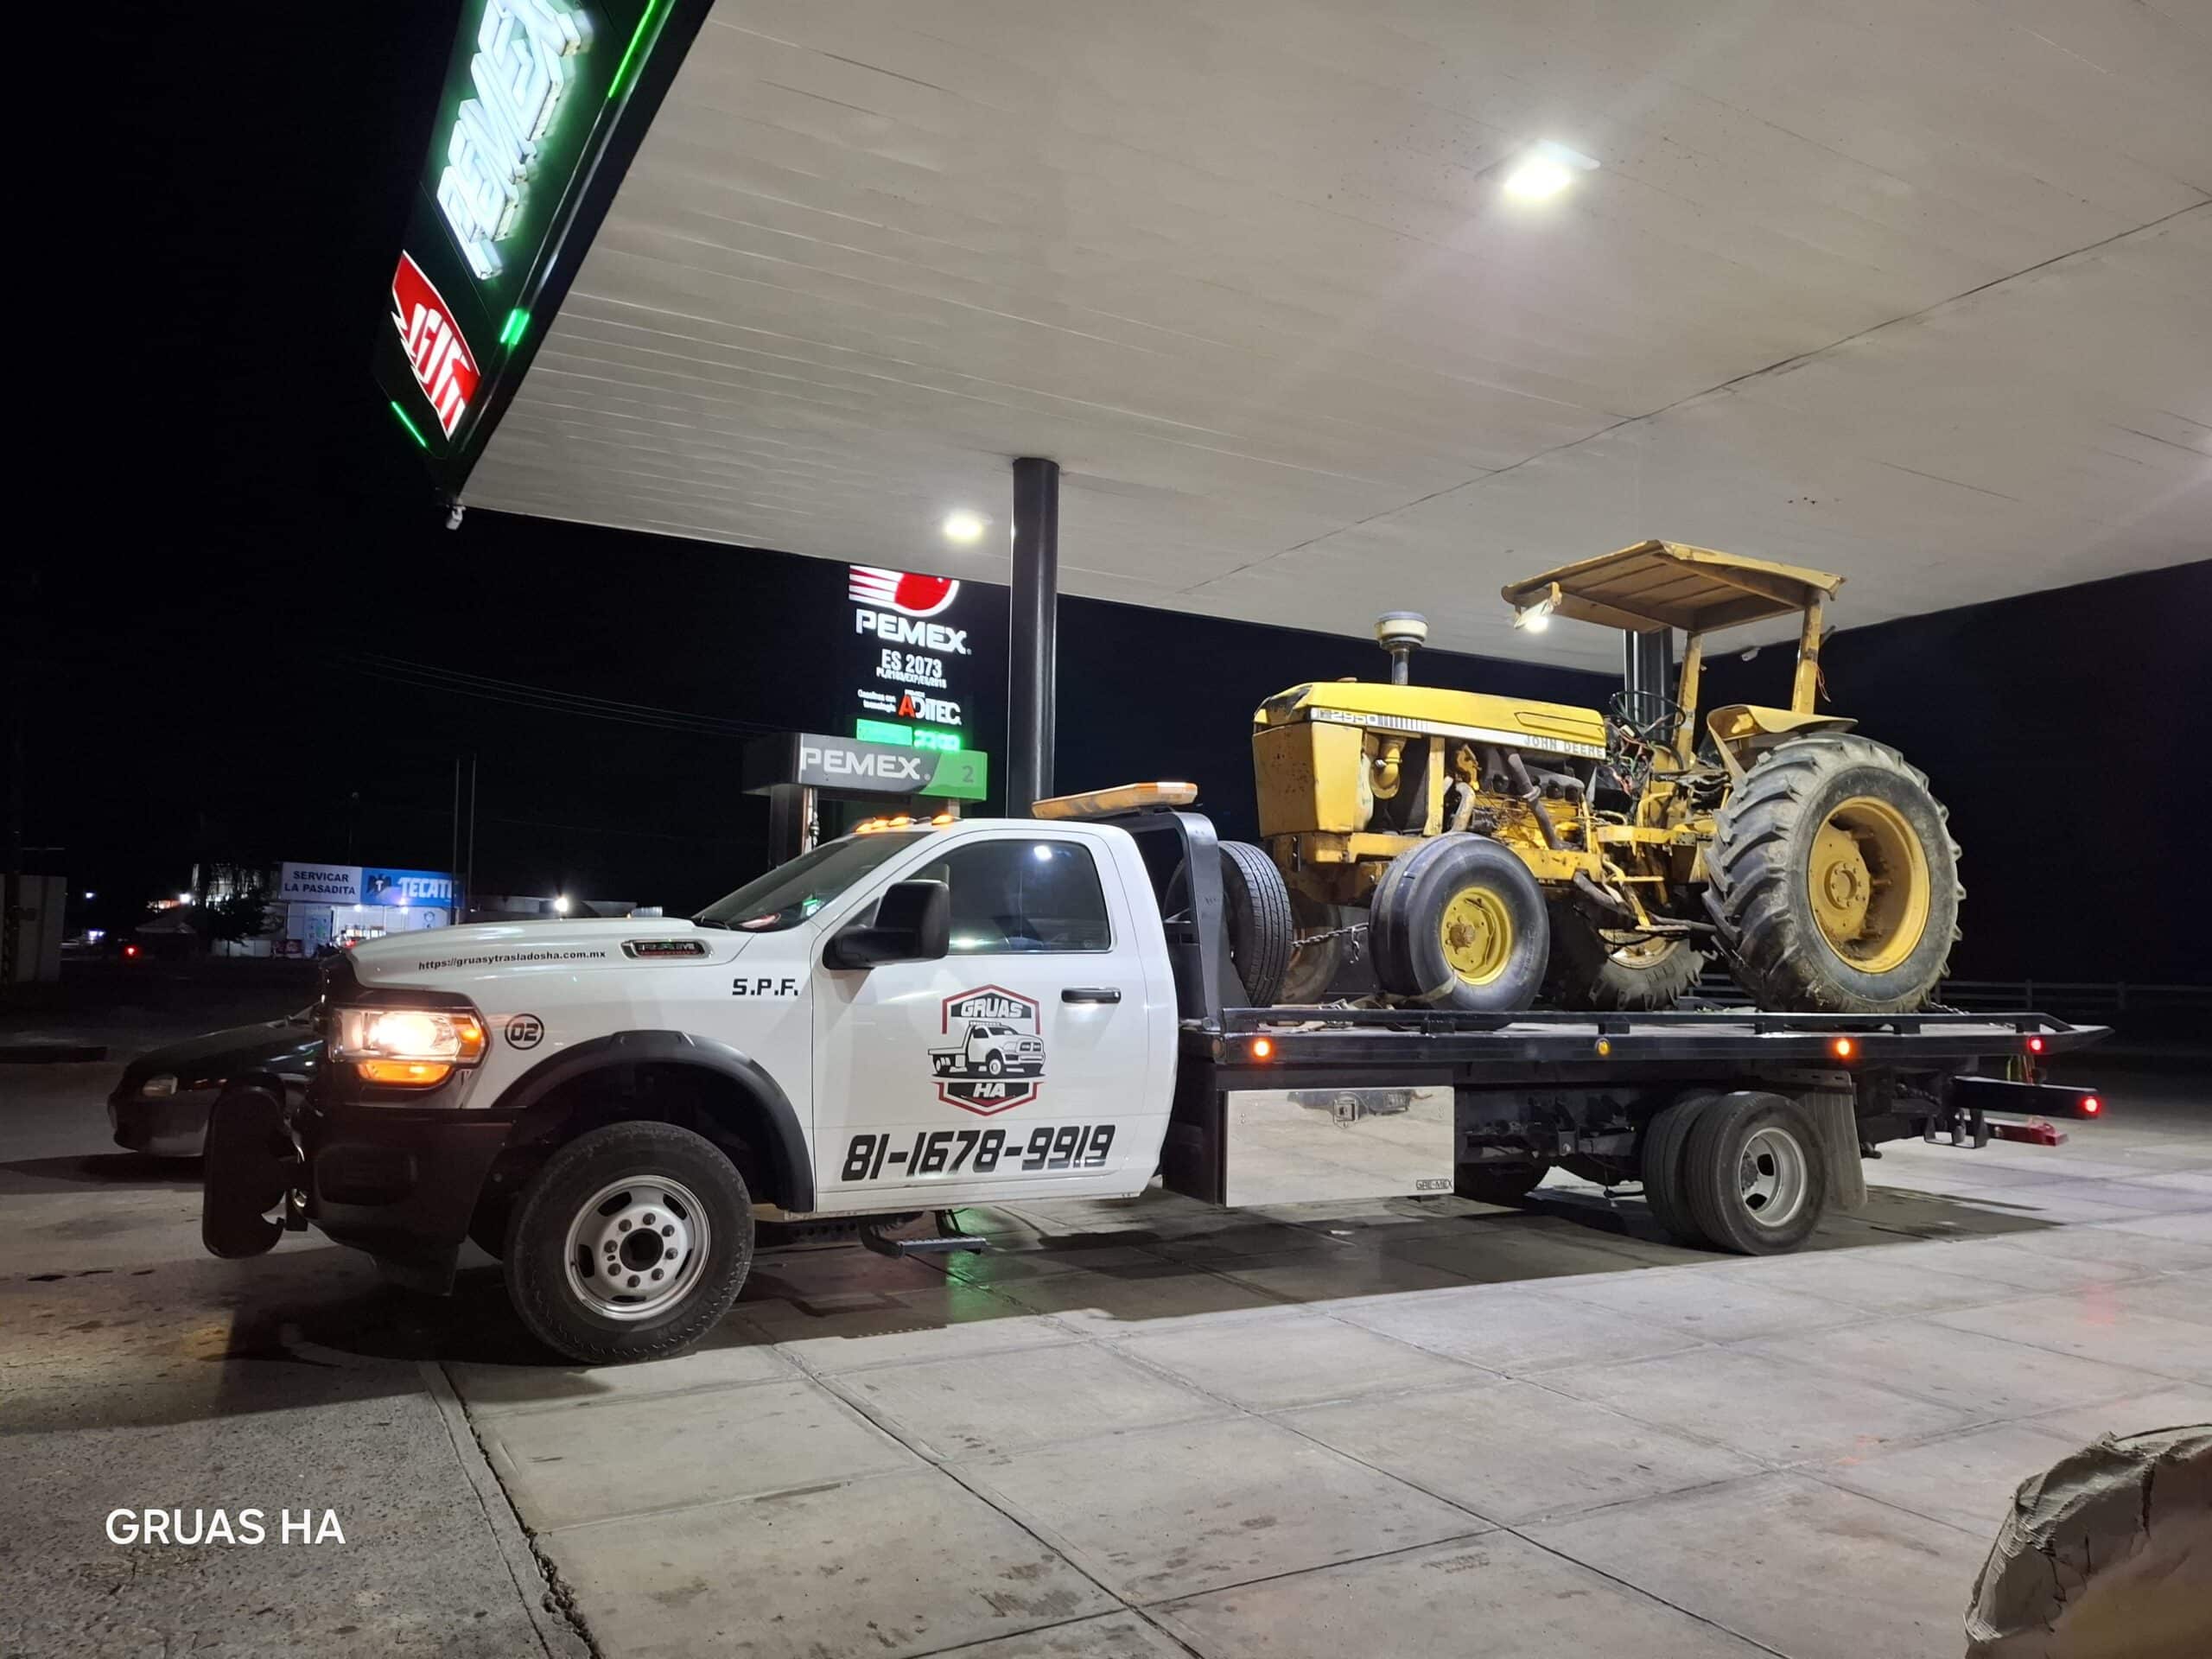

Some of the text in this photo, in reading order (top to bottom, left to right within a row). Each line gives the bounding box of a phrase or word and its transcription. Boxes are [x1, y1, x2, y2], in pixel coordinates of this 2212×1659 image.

[856, 608, 968, 655] PEMEX
[881, 648, 942, 679] ES 2073
[1523, 734, 1604, 758] JOHN DEERE
[801, 747, 921, 780] PEMEX
[962, 765, 975, 783] 2
[293, 871, 349, 882] SERVICAR
[284, 883, 355, 894] LA PASADITA
[418, 950, 606, 970] https://gruasytrasladosha.com.mx
[732, 978, 798, 995] S.P.F.
[961, 997, 1023, 1018] GRUAS
[510, 1022, 539, 1041] 02
[973, 1083, 1006, 1097] HA
[842, 1124, 1116, 1182] 81-1678-9919
